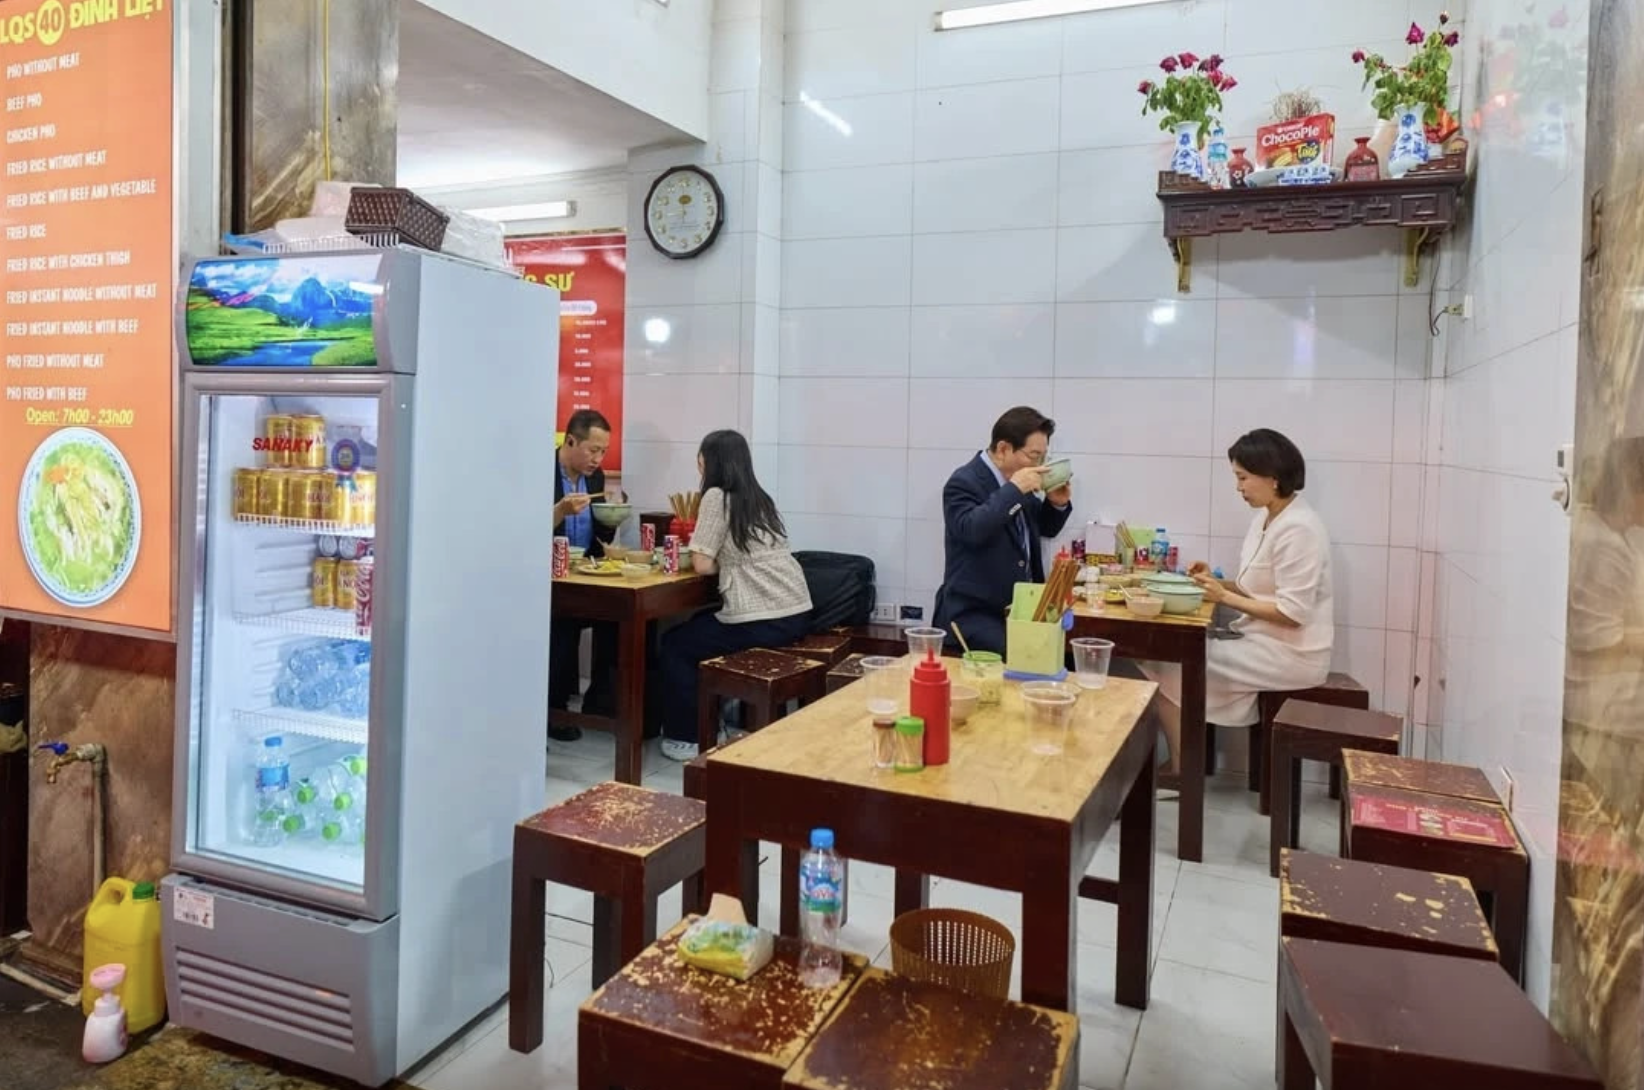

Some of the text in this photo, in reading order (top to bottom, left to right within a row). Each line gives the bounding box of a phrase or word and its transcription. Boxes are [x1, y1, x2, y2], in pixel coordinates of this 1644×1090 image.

[0, 12, 35, 43] LQS
[40, 7, 61, 34] 40
[23, 56, 57, 76] WITHOUT
[58, 52, 80, 70] MEAT
[6, 95, 24, 112] BEEF
[6, 126, 38, 144] CHICKEN
[6, 150, 107, 176] FRIED RICE WITHOUT MEAT
[6, 179, 156, 208] FRIED RICE WITH BEEF AND VEGETABLE
[6, 224, 47, 240] FRIED RICE
[6, 249, 131, 273] FRIED RICE WITH CHICKEN THIGH
[6, 283, 157, 305] FRIED INSTANT NOODLE WITHOUT MEAT
[6, 319, 139, 337] FRIED INSTANT NOODLE WITH BEEF
[6, 353, 104, 368] PHO FRIED WITHOUT MEAT
[6, 386, 88, 402] PHO FRIED WITH BEEF
[26, 407, 60, 425] Open:
[63, 408, 90, 424] 7h00
[98, 408, 134, 425] 23h00
[252, 437, 314, 453] SANAKY
